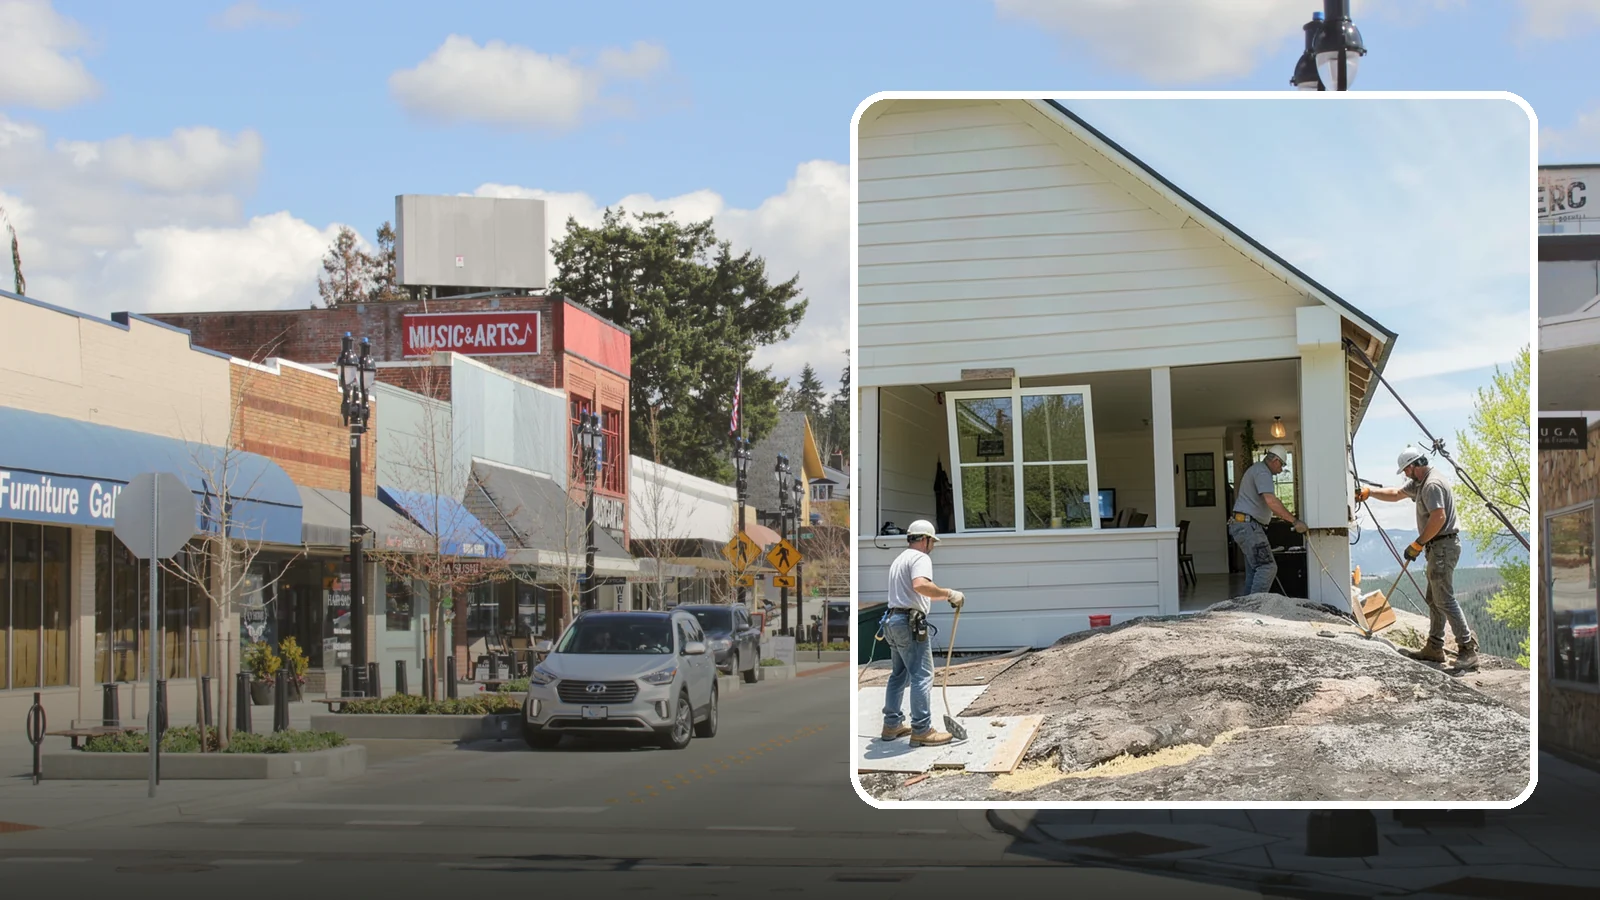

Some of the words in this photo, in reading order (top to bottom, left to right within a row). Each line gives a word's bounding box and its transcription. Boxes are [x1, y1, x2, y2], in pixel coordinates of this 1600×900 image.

[409, 323, 519, 348] MUSIC&ARTS
[1540, 427, 1578, 437] UGA
[0, 471, 79, 515] Furniture
[89, 482, 122, 519] Gal
[453, 563, 480, 575] SUSHI
